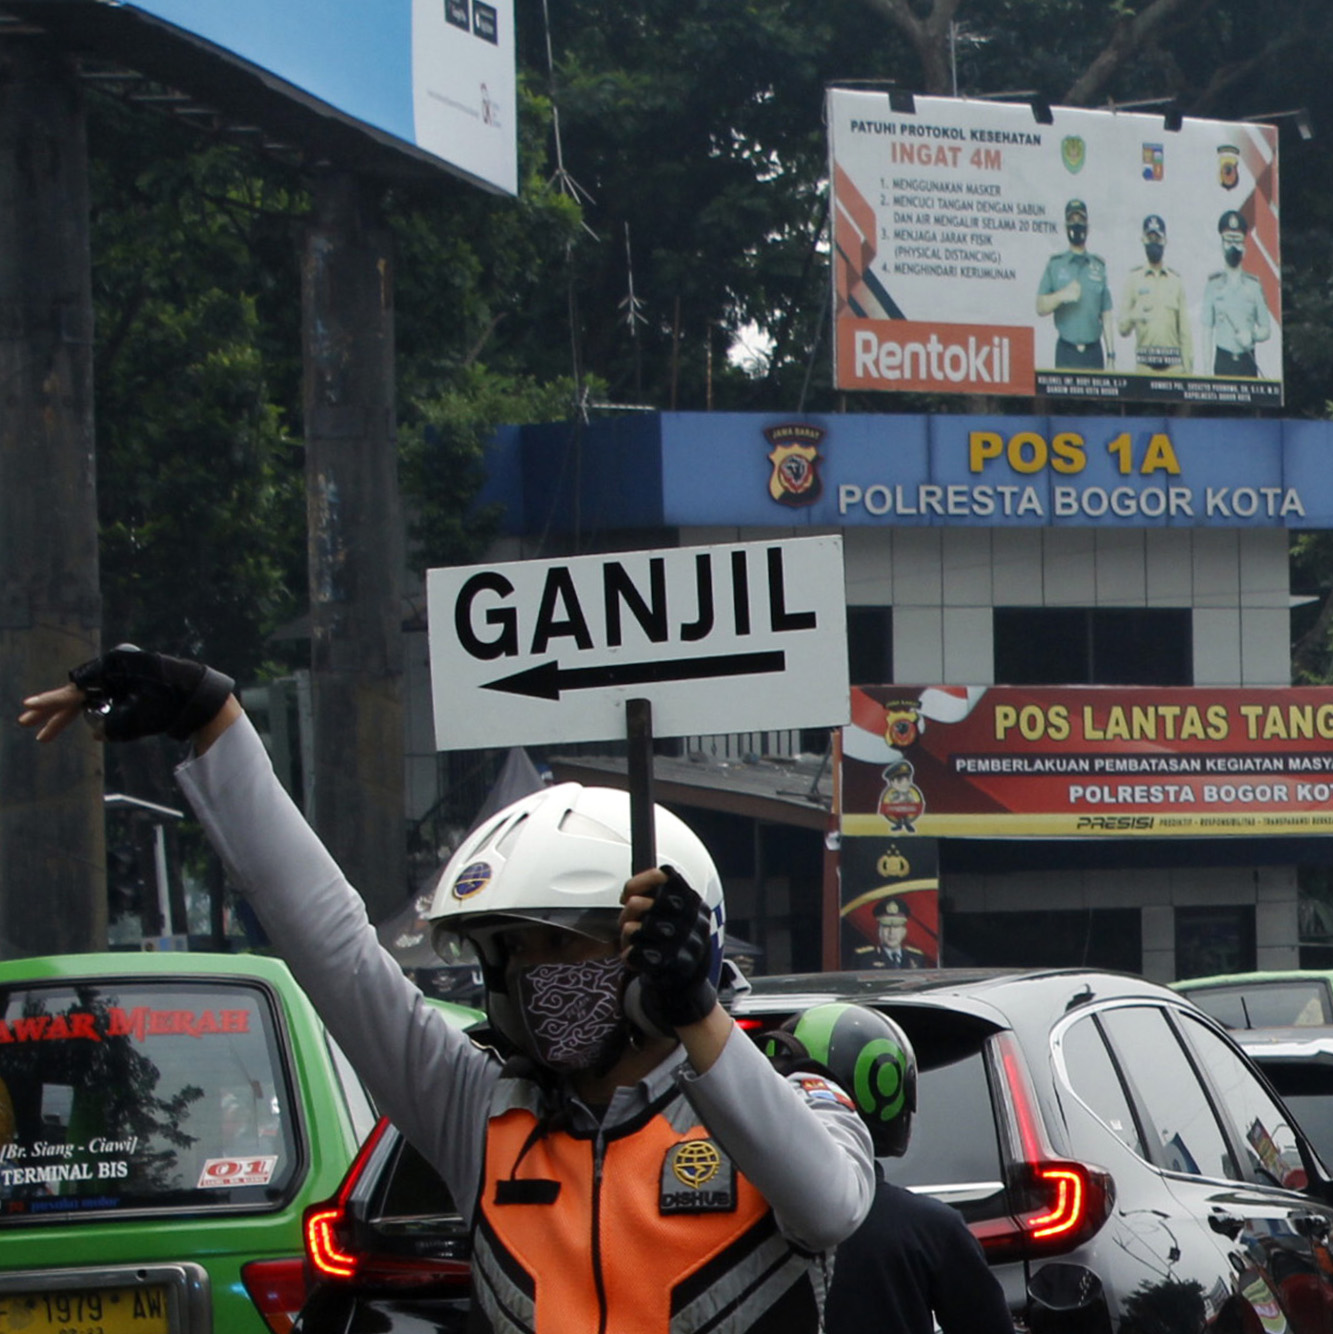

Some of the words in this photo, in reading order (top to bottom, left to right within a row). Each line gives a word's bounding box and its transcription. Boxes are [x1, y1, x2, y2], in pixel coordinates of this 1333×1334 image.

[850, 120, 896, 135] PATUHI
[900, 124, 966, 140] PROTOKOL
[970, 129, 1042, 146] KESEHATAN
[891, 142, 963, 168] INGAT
[970, 147, 1002, 170] 4M
[892, 179, 964, 194] MENGGUNAKAN
[966, 184, 1001, 195] MASKER
[893, 196, 935, 209] MENCUCI
[937, 199, 973, 212] TANGAN
[976, 202, 1014, 214] DENGAN
[1016, 205, 1046, 216] SABUN
[894, 212, 913, 224] DAN
[916, 214, 931, 225] AIR
[934, 214, 980, 228] MENGALIR
[982, 219, 1016, 231] SELAMA
[1032, 222, 1058, 233] DETIK
[894, 229, 938, 243] MENJAGA
[940, 232, 968, 244] JARAK
[970, 234, 993, 246] FISIK
[894, 263, 958, 277] MENGHINDARI
[854, 331, 1010, 384] Rentokil
[969, 431, 1087, 474] POS
[1107, 433, 1181, 474] 1A
[838, 484, 1044, 516] POLRESTA
[1054, 486, 1194, 517] BOGOR
[1205, 487, 1306, 517] KOTA
[454, 546, 817, 661] GANJIL
[995, 704, 1070, 741] POS
[1083, 704, 1230, 741] LANTAS
[955, 757, 1090, 773] PEMBERLAKUAN
[1094, 757, 1201, 772] PEMBATASAN
[1206, 757, 1284, 772] KEGIATAN
[1069, 784, 1196, 803] POLRESTA
[1203, 783, 1288, 803] BOGOR
[1076, 816, 1155, 830] PRESISI
[0, 1012, 101, 1045] AWAR
[106, 1006, 250, 1043] MERAH
[31, 1141, 75, 1159] Siang
[1, 1164, 93, 1186] TERMINAL
[97, 1161, 128, 1179] BIS
[43, 1295, 103, 1324] 1979
[133, 1290, 162, 1319] AW
